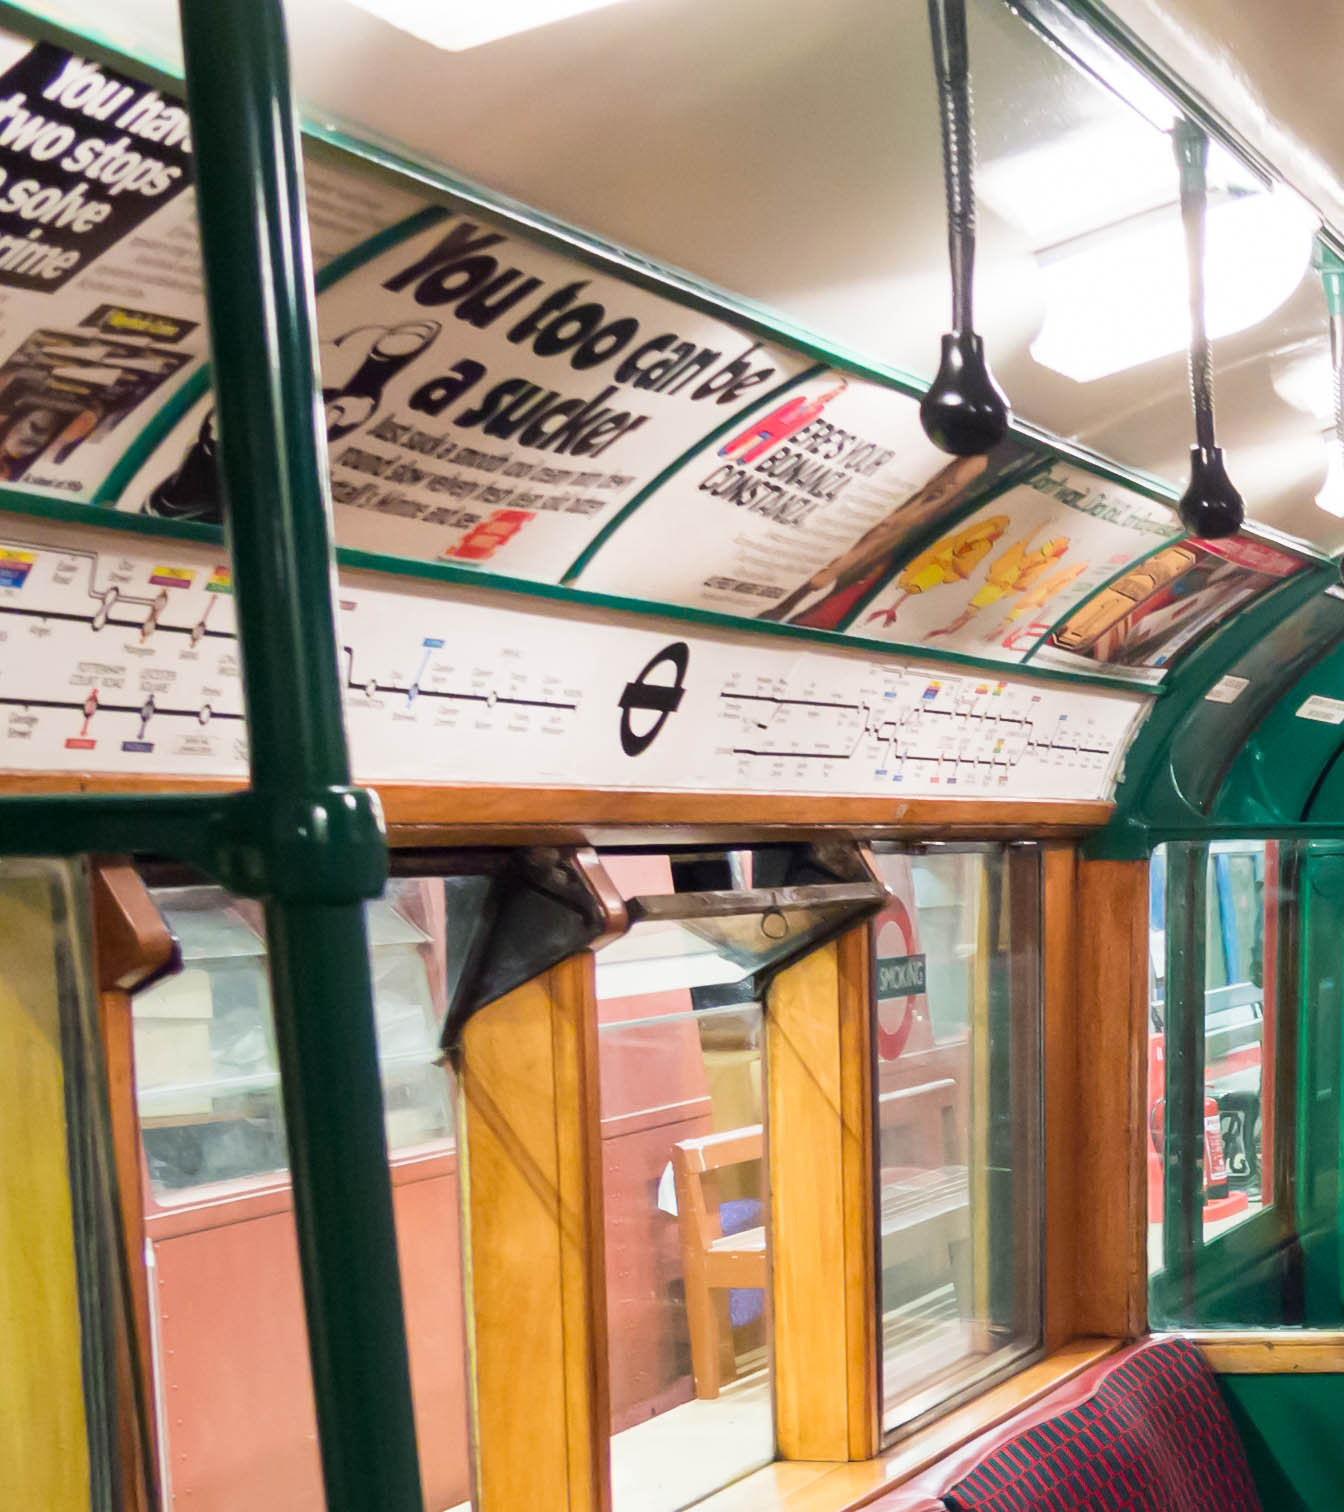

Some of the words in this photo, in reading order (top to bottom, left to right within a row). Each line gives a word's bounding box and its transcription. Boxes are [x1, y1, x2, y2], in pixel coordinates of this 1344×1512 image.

[0, 92, 76, 161] two
[60, 136, 182, 196] stops
[42, 56, 135, 121] You
[115, 90, 192, 152] hav
[0, 179, 112, 233] solve
[0, 228, 81, 279] rime
[381, 222, 545, 329] You
[507, 280, 639, 371] too
[614, 333, 722, 395] can
[690, 342, 776, 405] be
[408, 358, 488, 416] a
[453, 378, 654, 458] sucker
[879, 961, 925, 992] SMOKING
